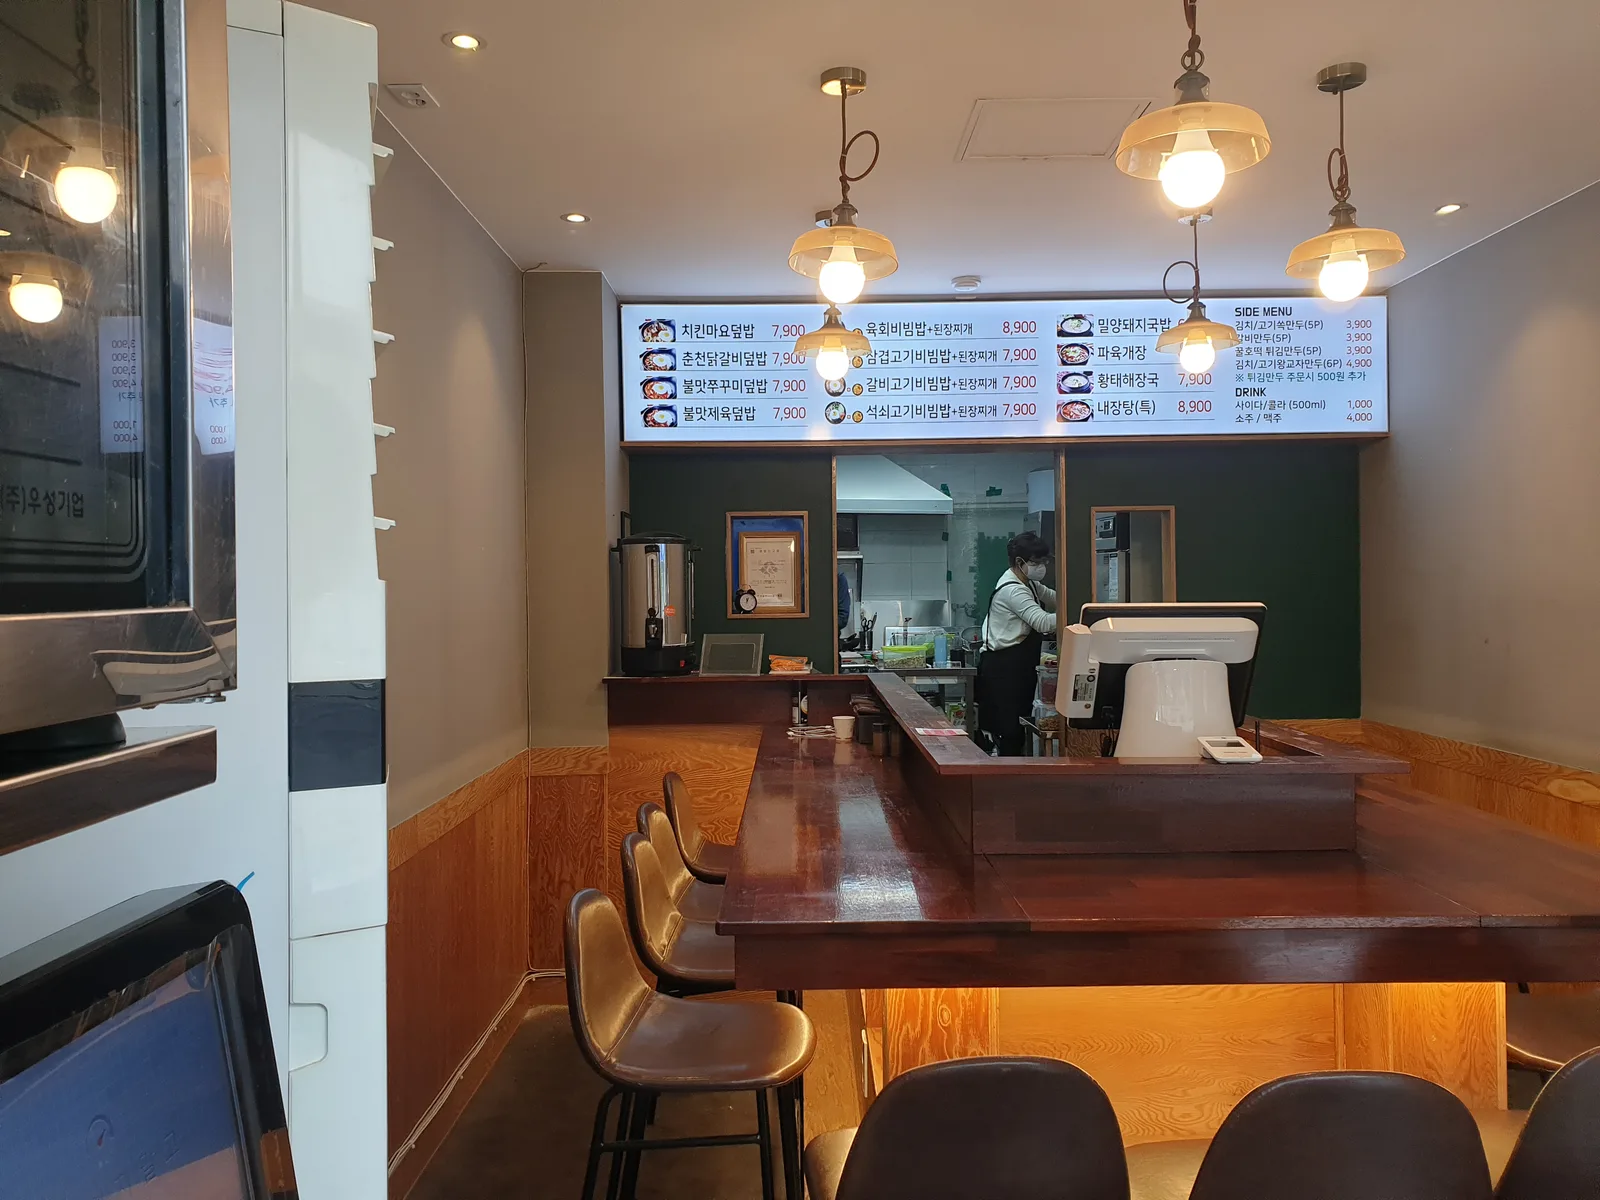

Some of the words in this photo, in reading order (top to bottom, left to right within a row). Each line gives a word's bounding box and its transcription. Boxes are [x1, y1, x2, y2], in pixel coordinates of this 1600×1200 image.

[1235, 306, 1260, 317] SIDE
[1262, 306, 1292, 316] MENU
[682, 324, 755, 339] 치킨마요덮밥
[772, 324, 806, 338] 7,900
[866, 322, 973, 337] 육회비빔밥+된장찌개
[1002, 320, 1036, 335] 8,900
[1098, 317, 1172, 334] 밀양돼지국밥
[1346, 320, 1372, 330] 3,900
[1346, 333, 1372, 343] 3,900
[682, 351, 767, 366] 춘천닭갈비덮밥
[772, 352, 806, 366] 7,900
[866, 348, 997, 365] 삼겹고기비빔밥+된장찌개
[1002, 348, 1036, 363] 7,900
[1097, 346, 1147, 361] 파육개장
[1235, 347, 1263, 357] 꿀호떡
[1265, 346, 1322, 357] 튀김만두(5P)
[1346, 346, 1372, 356] 3,900
[1235, 359, 1343, 370] 김치/고기왕교자만두(6P)
[1346, 359, 1372, 369] 4,900
[866, 376, 997, 392] 갈비고기비빔밥+된장찌개
[1002, 376, 1036, 391] 7,900
[1097, 373, 1159, 389] 황태해장국
[1178, 373, 1212, 388] 7,900
[1247, 372, 1284, 382] 튀김만두
[1287, 372, 1314, 382] 주문시
[1317, 372, 1344, 382] 500원
[1348, 371, 1366, 381] 추가
[683, 379, 767, 394] 불맛쭈꾸미덮밥
[772, 379, 806, 394] 7,900
[1235, 388, 1266, 397] DRINK
[866, 403, 997, 419] 석쇠고기비빔밥+된장찌개
[1002, 403, 1036, 418] 7,900
[1098, 400, 1156, 416] 내장탕(특)
[1178, 400, 1212, 414] 8,900
[1235, 400, 1286, 410] 사이다/콜라
[1289, 400, 1326, 410] (500ml)
[1348, 400, 1372, 409] 1,000
[683, 406, 756, 421] 불맛제육덮밥
[773, 406, 806, 421] 7,900
[1235, 414, 1254, 423] 소주
[1263, 413, 1282, 423] 맥주
[1346, 412, 1372, 422] 4,000
